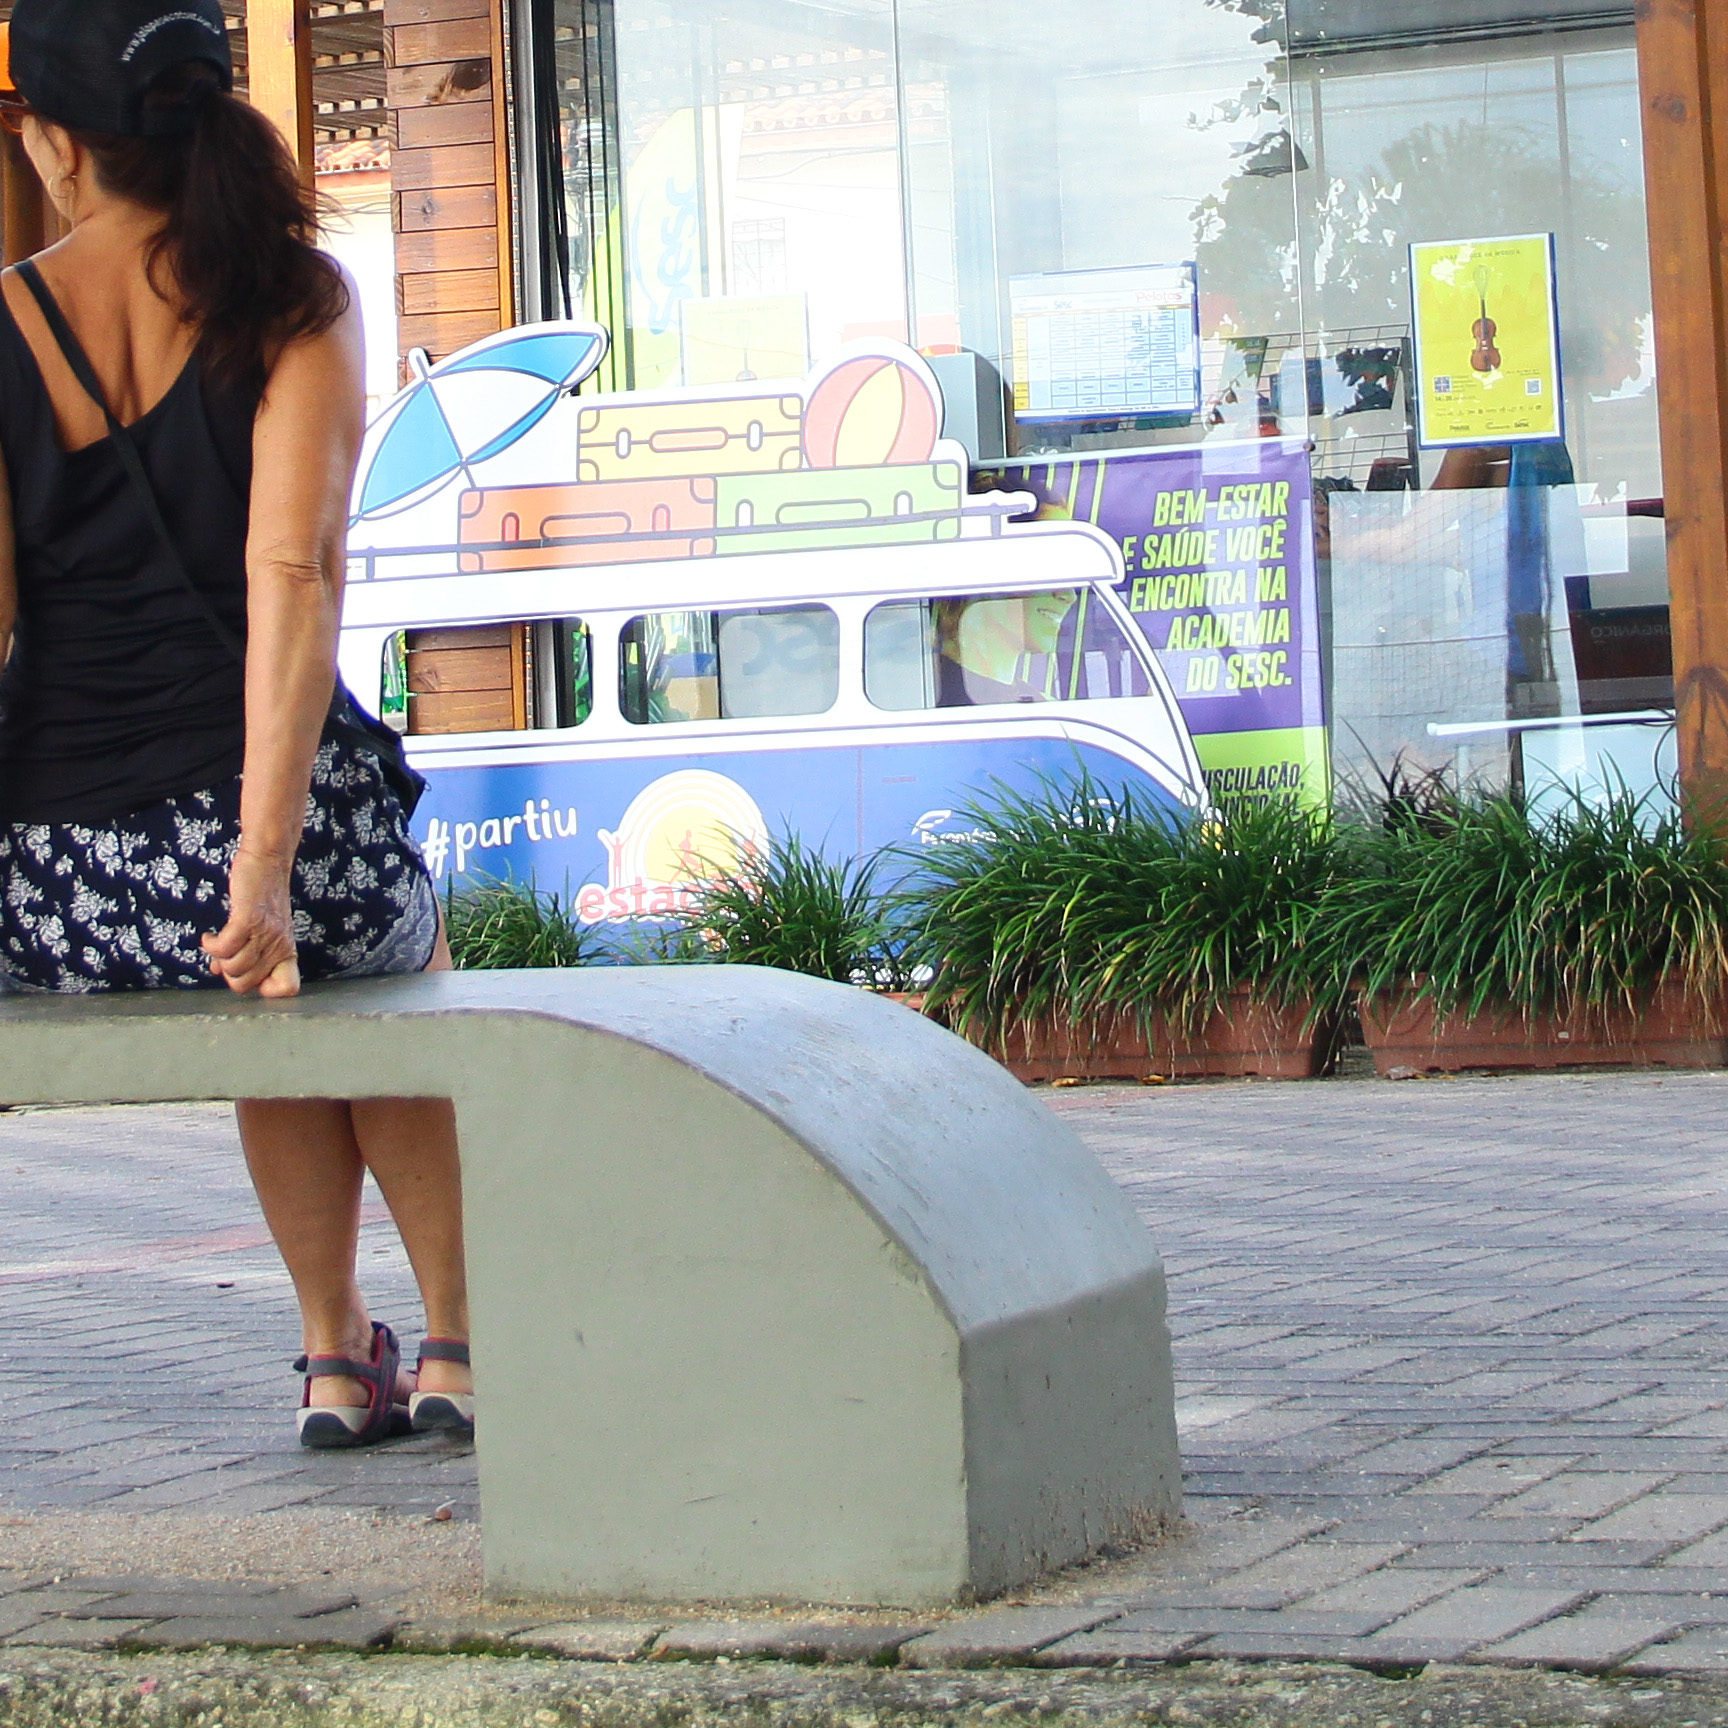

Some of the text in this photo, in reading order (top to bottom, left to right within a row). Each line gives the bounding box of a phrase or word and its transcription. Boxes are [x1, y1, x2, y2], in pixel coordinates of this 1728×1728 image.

[1153, 481, 1290, 527] BEM-ESTAR
[1141, 527, 1220, 570] SAÚDE
[1225, 518, 1288, 563] VOCÊ
[1129, 566, 1287, 613] ENCONTRA NA
[1165, 607, 1291, 651] ACADEMIA
[1185, 650, 1293, 693] DO SESC.
[1203, 761, 1304, 792] USCULAÇÃO,
[420, 798, 578, 879] #partiu
